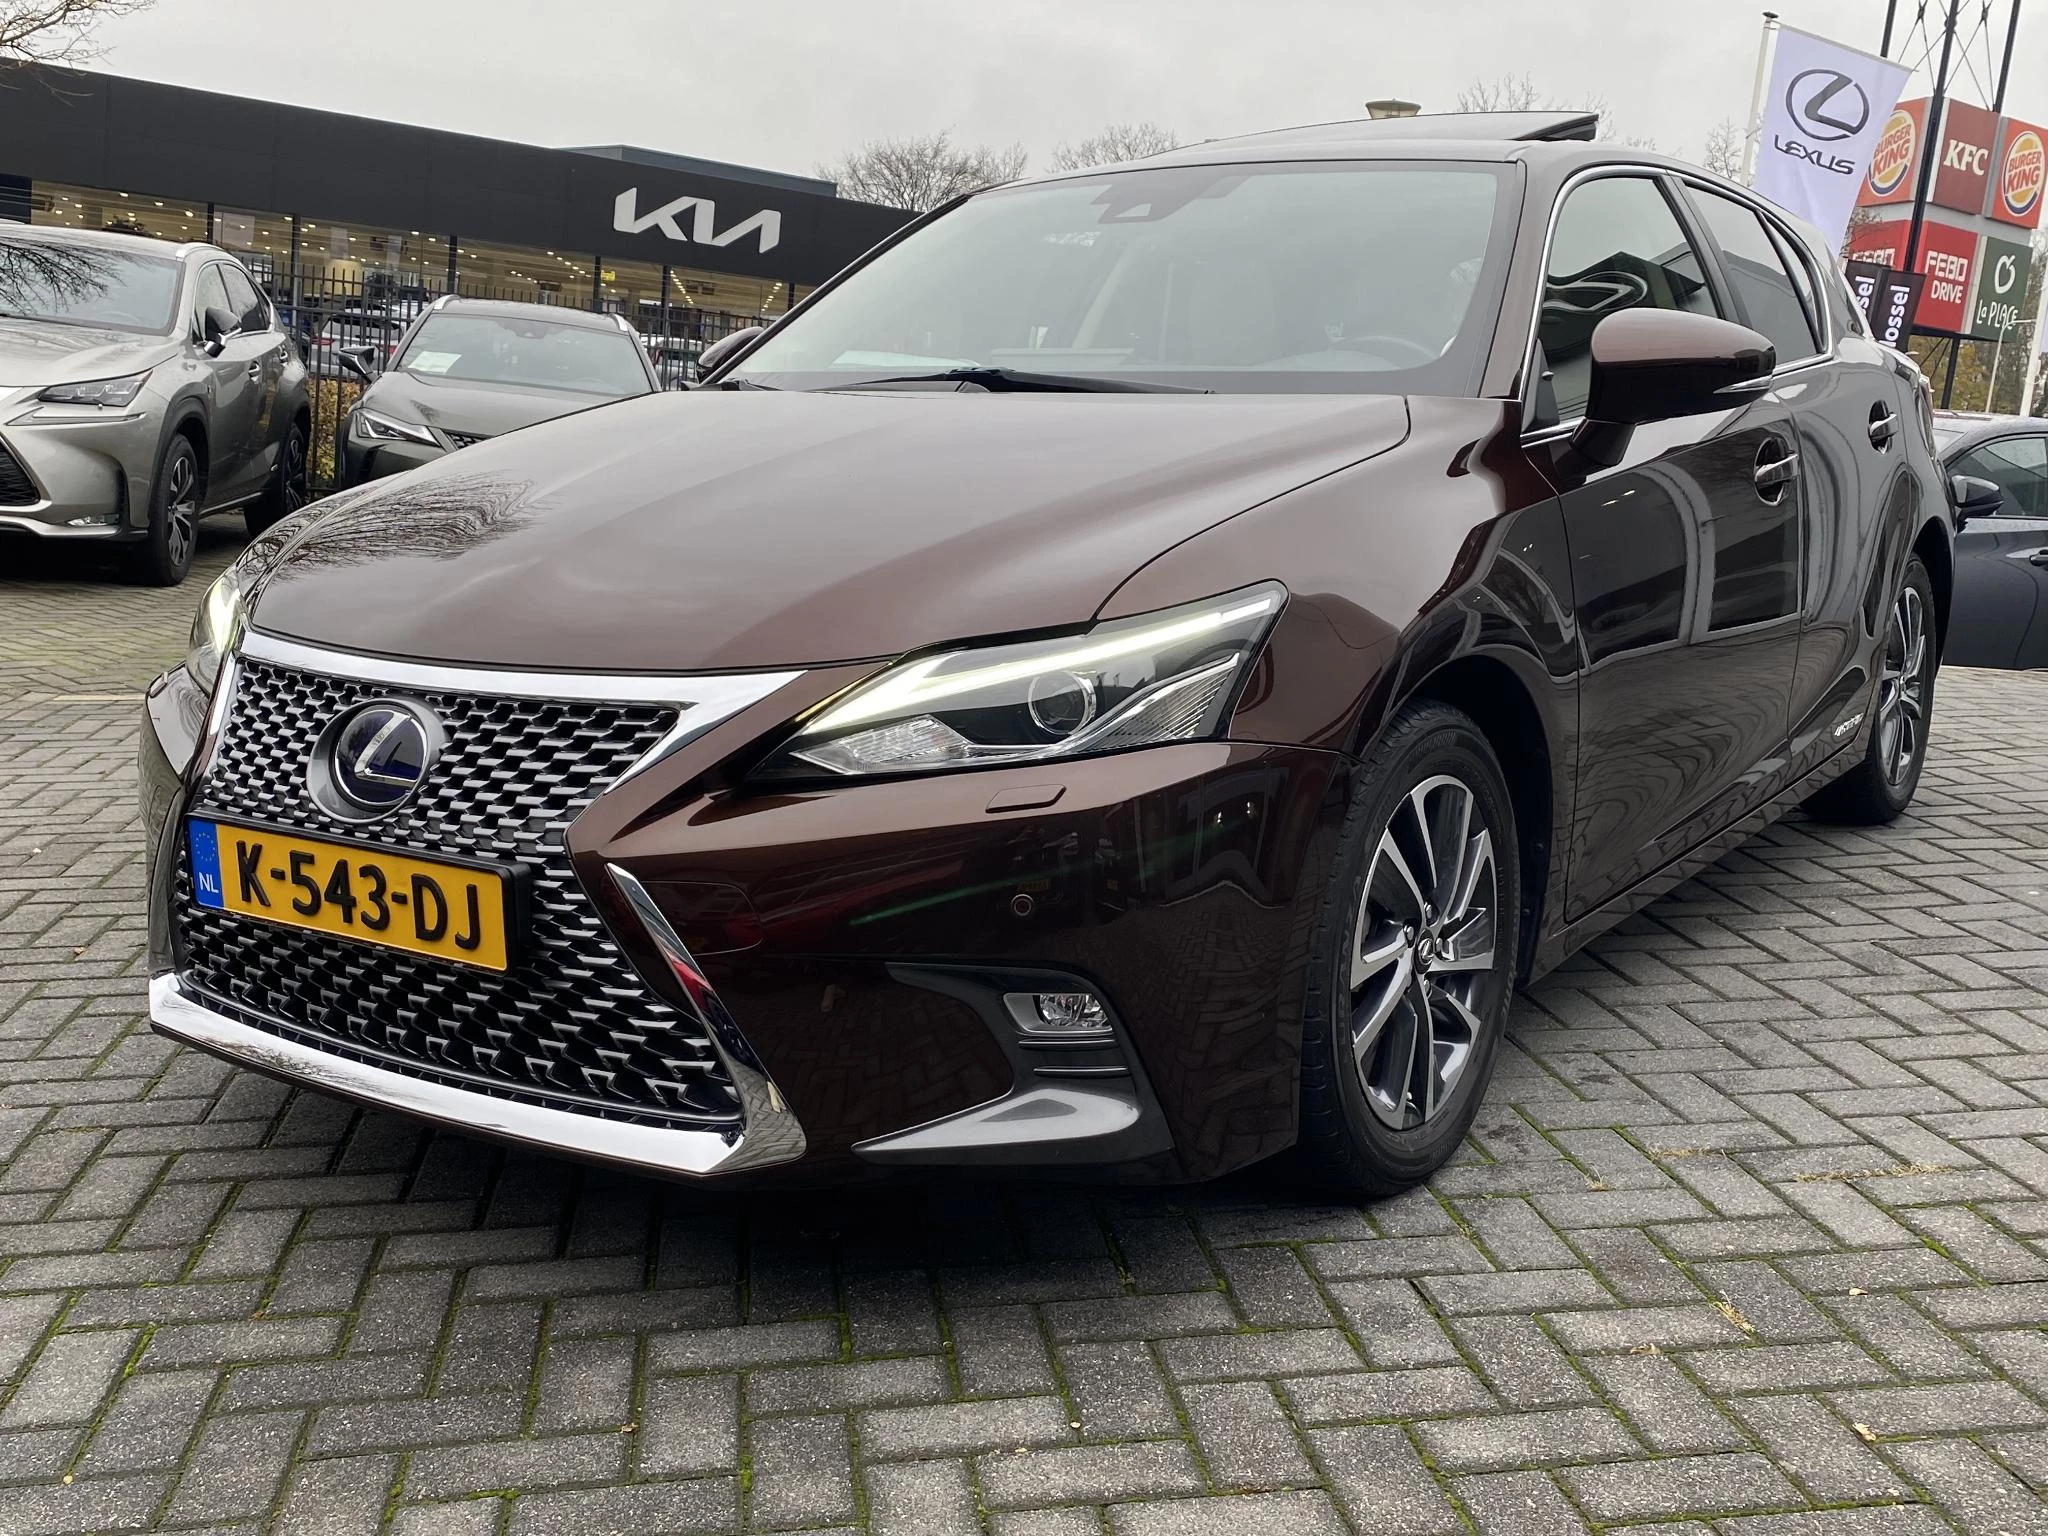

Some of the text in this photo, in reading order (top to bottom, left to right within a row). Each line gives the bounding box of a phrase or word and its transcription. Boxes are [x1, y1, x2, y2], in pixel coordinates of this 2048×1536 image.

[1774, 134, 1855, 175] LEXUS
[1872, 138, 1911, 180] KING
[1873, 123, 1912, 160] BURGER
[1943, 139, 1989, 176] KFC
[2006, 165, 2041, 194] KING
[2008, 151, 2042, 173] BURGER
[613, 187, 781, 253] KIA
[1925, 250, 1968, 282] FEBO
[1930, 280, 1963, 304] DRIVE
[1879, 284, 1911, 348] ossel
[1976, 299, 1987, 324] La
[198, 871, 220, 894] NL
[236, 840, 481, 950] K-543-DJ
